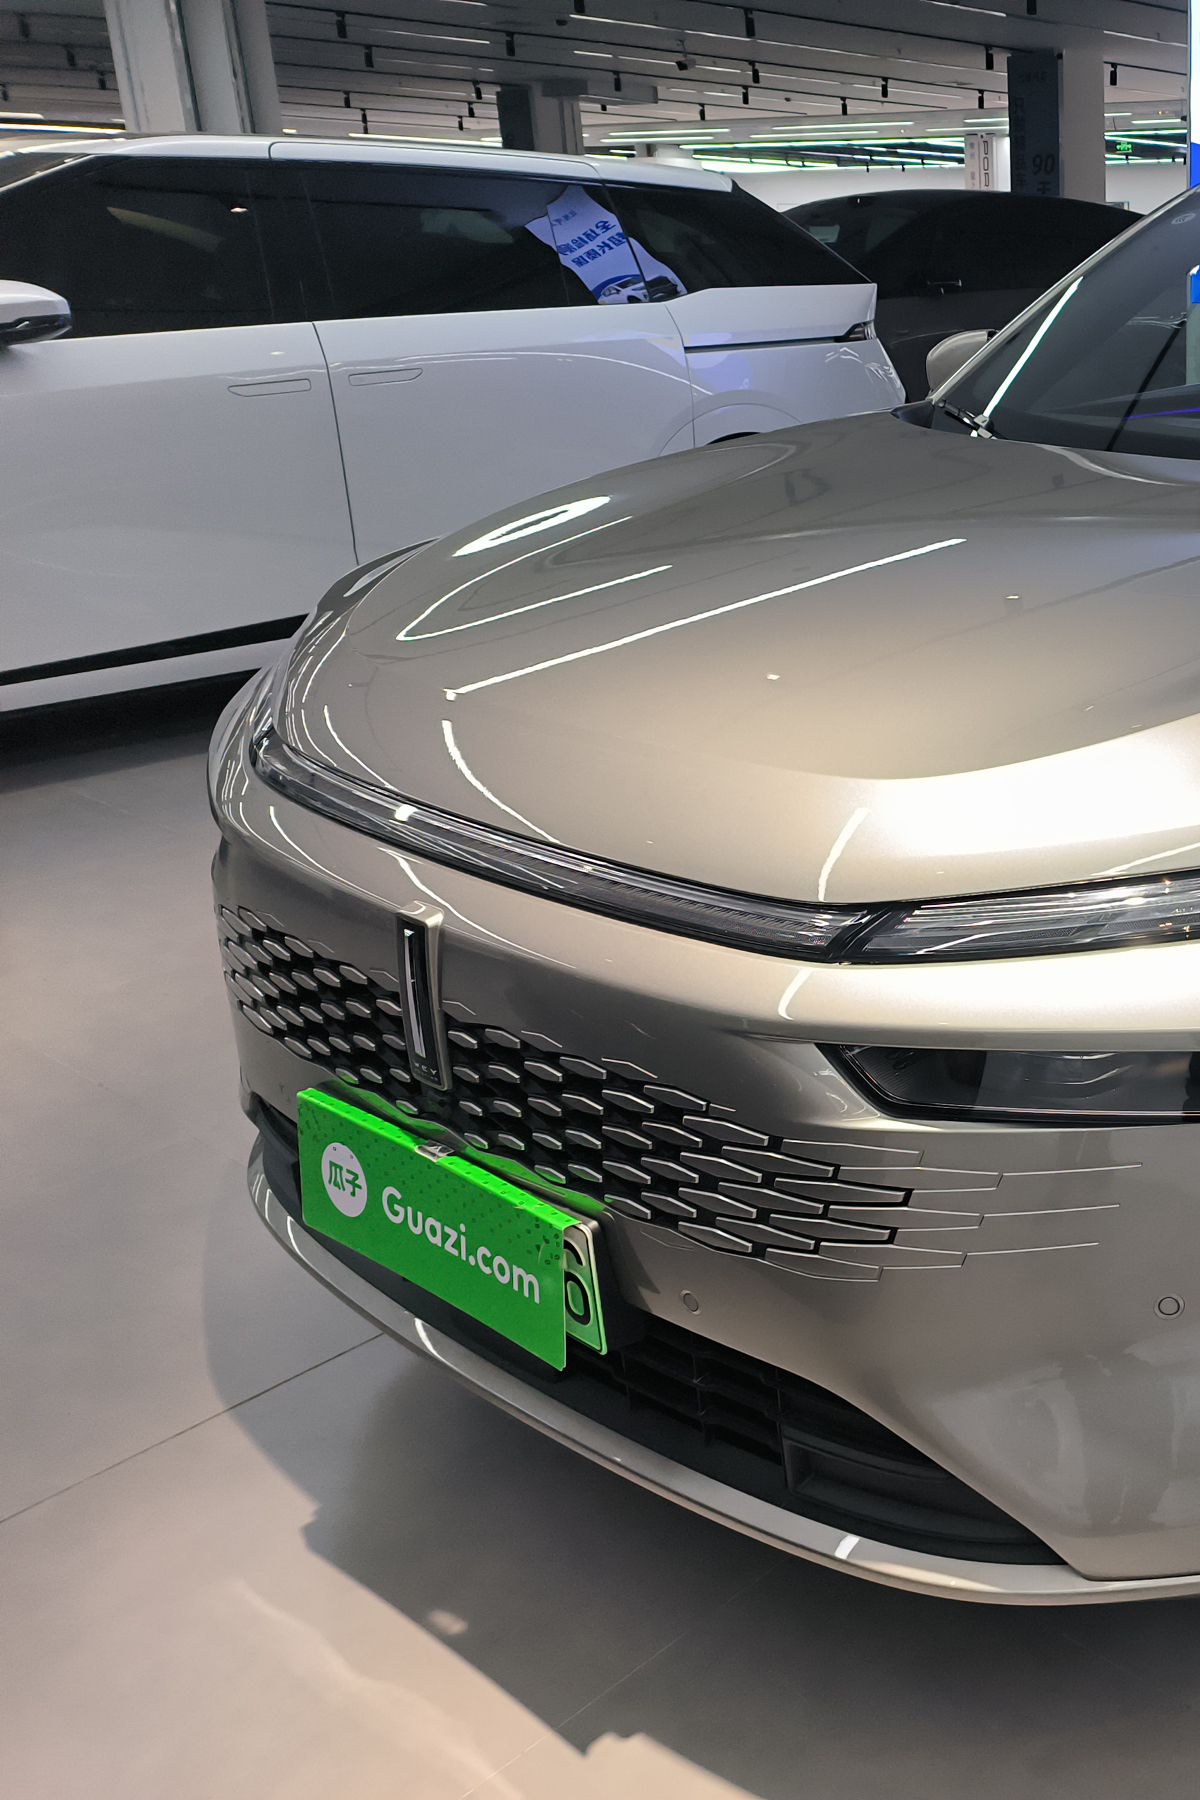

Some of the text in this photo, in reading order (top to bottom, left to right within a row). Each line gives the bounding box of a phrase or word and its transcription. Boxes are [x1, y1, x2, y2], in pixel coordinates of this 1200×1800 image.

[1032, 152, 1056, 176] 90
[328, 1160, 363, 1198] 瓜子
[382, 1187, 541, 1305] Guazi.com
